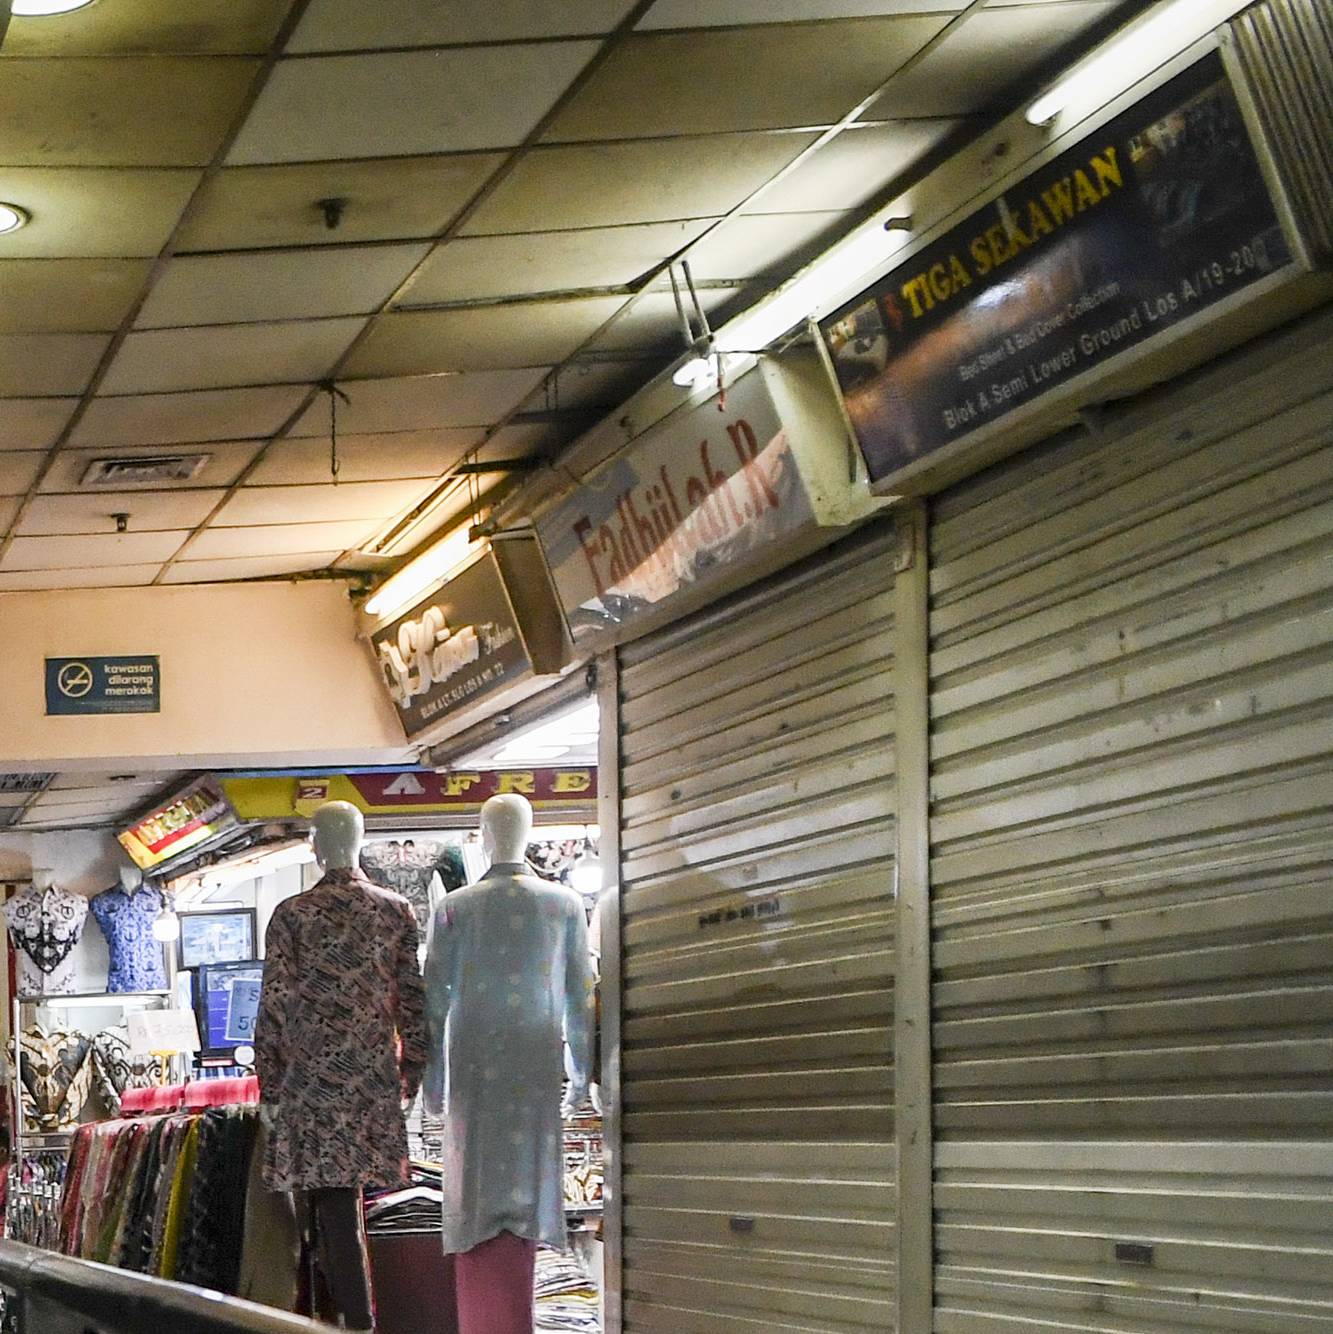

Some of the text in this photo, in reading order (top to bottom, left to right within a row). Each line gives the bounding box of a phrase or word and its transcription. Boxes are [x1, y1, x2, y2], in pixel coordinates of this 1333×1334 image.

[901, 147, 1124, 318] TIGA SEKAWAN
[943, 398, 978, 430] Blok
[979, 391, 992, 412] A
[991, 371, 1029, 404] Semi
[1030, 347, 1077, 384] Lower
[1080, 310, 1142, 356] Ground
[1142, 290, 1178, 323] Los
[104, 664, 153, 674] kawasan
[108, 674, 153, 686] dilarang
[105, 685, 153, 696] merokok
